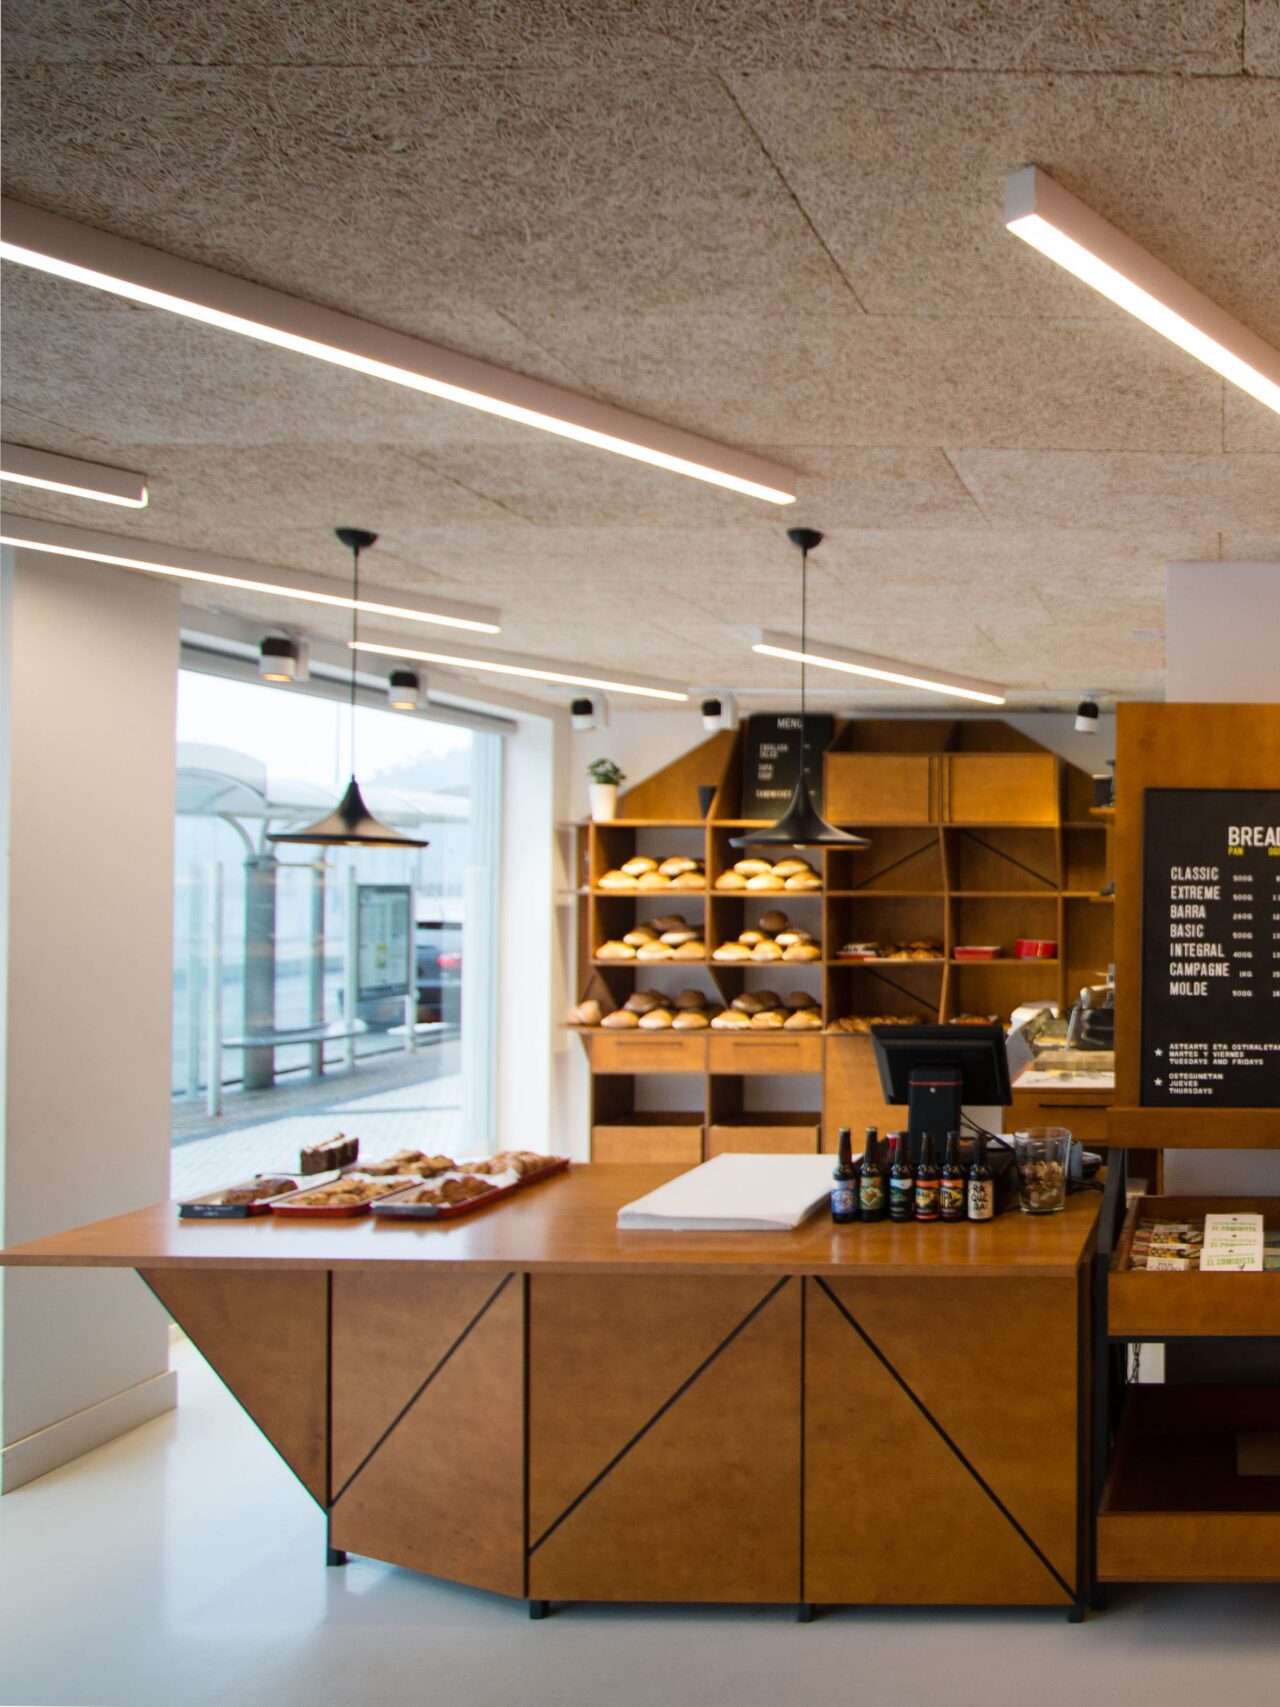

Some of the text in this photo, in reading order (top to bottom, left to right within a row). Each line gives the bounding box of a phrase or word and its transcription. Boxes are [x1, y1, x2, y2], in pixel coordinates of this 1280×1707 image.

[1228, 848, 1245, 856] PAN
[1170, 866, 1220, 881] CLASSIC
[1170, 885, 1221, 901] EXTREME
[1170, 904, 1207, 920] BARRA
[1170, 923, 1206, 939] BASIC
[1170, 943, 1226, 959] INTEGRAL
[1169, 962, 1231, 978] CAMPAGNE
[1169, 981, 1209, 997] MOLDE
[1169, 1043, 1208, 1051] ASTEARTE
[1212, 1043, 1228, 1051] ETA
[1169, 1051, 1199, 1059] MARTES
[1212, 1051, 1245, 1059] VIERNES
[1169, 1058, 1265, 1066] TUESDAYS AND FRIDAYS
[1168, 1073, 1224, 1081] OSTEGUNETAN
[1217, 1257, 1255, 1265] COMIDISTA
